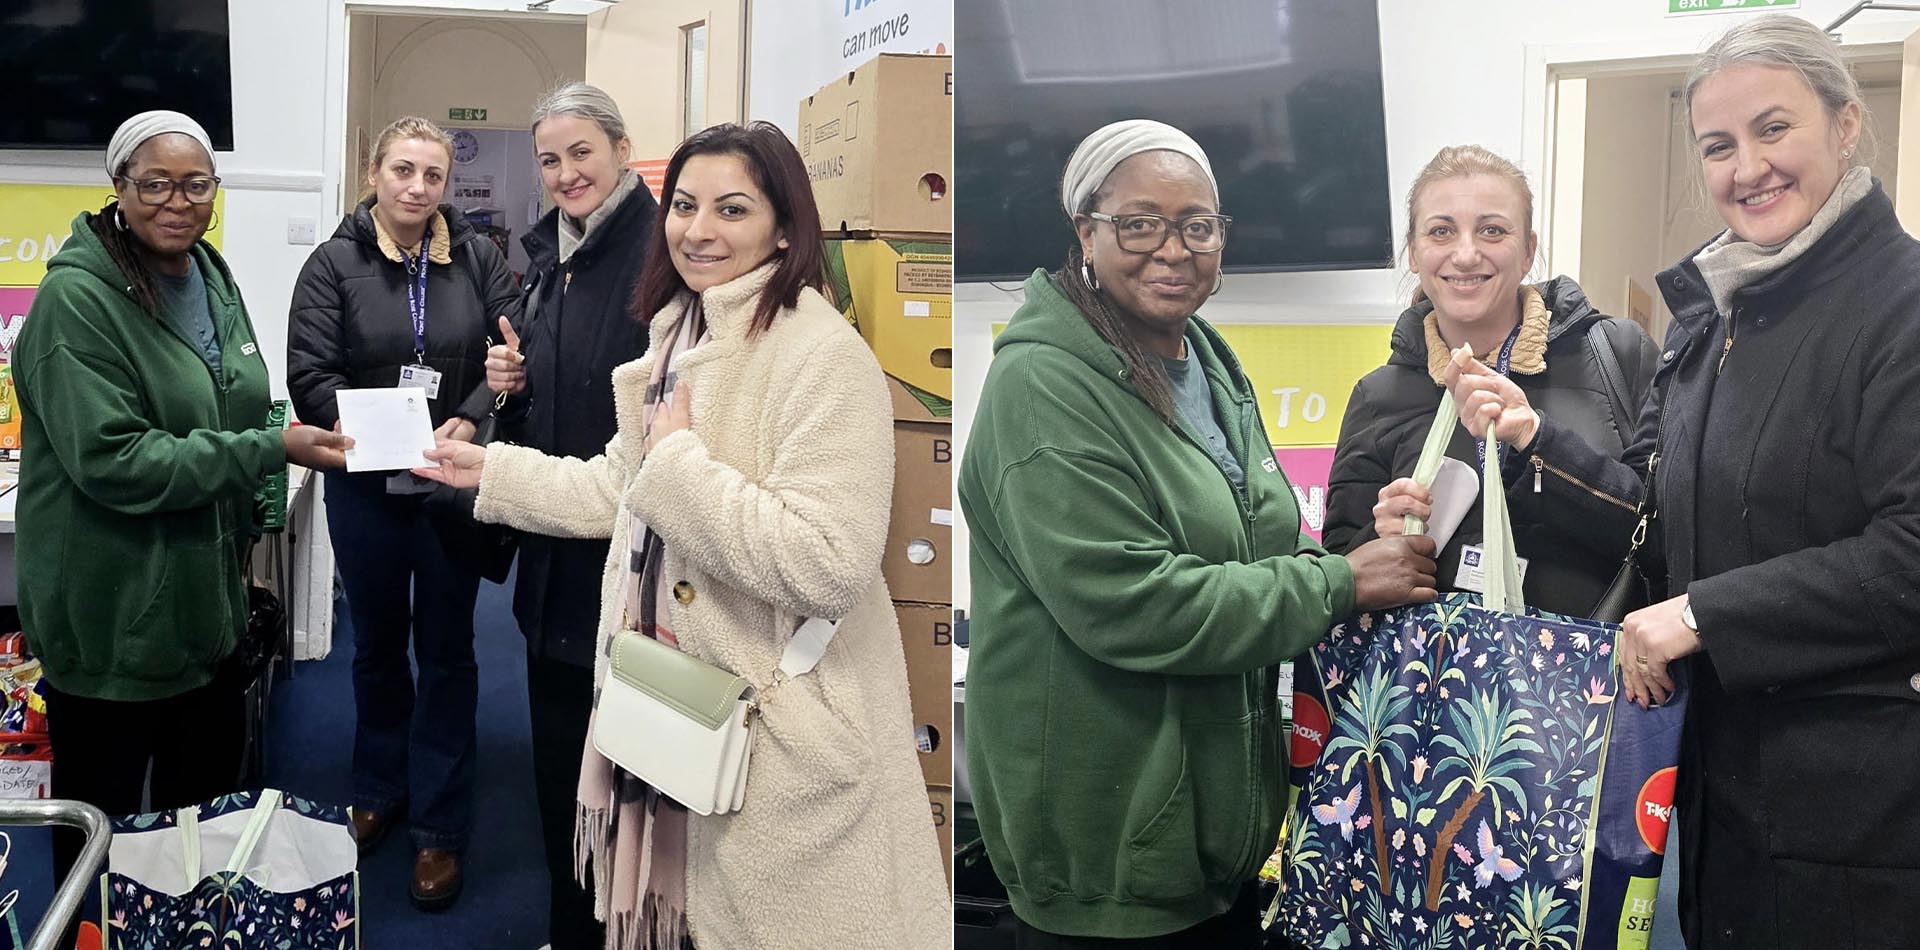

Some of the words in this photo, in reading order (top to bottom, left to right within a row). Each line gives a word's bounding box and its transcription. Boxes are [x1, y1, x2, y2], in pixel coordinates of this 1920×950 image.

[843, 31, 866, 58] can
[869, 13, 909, 49] move
[1272, 387, 1327, 429] TO
[934, 439, 952, 463] B
[934, 622, 952, 646] B
[0, 764, 32, 779] GED/
